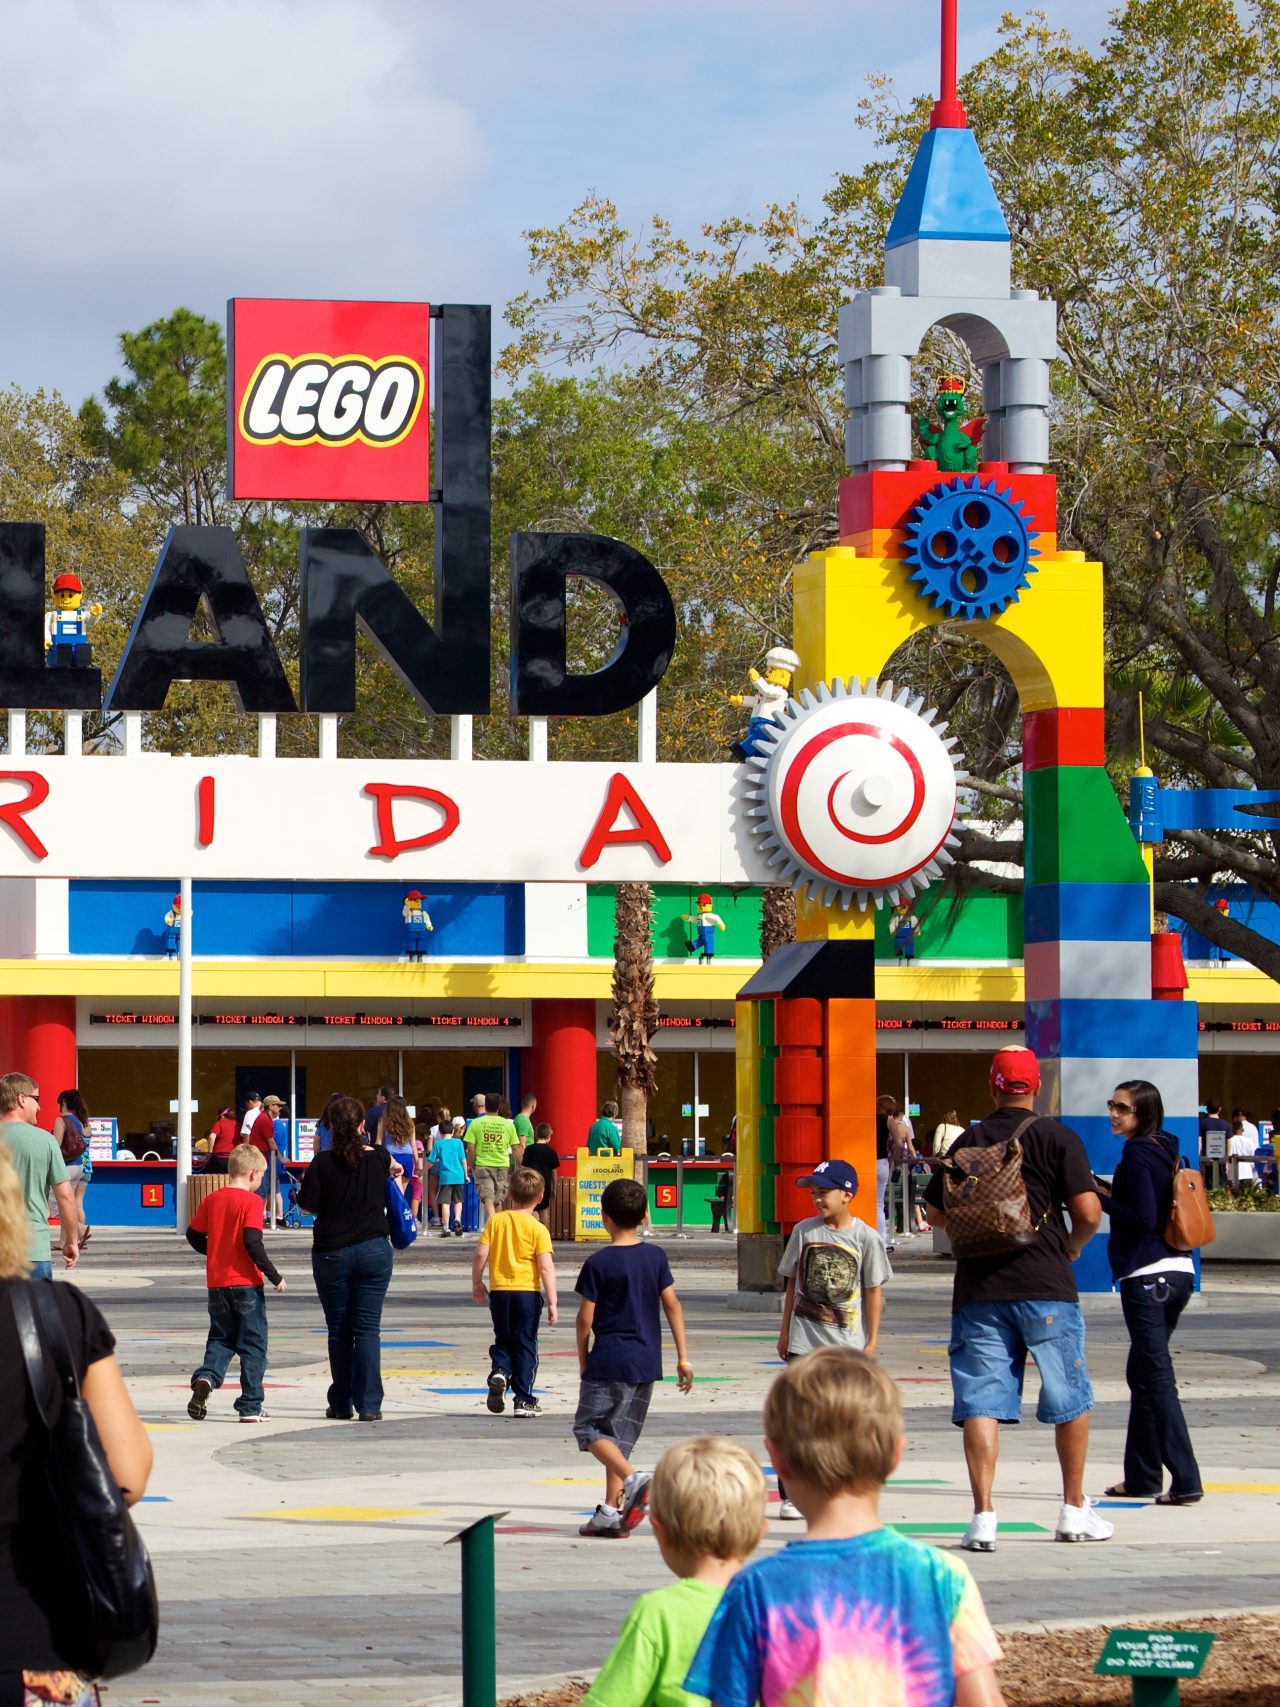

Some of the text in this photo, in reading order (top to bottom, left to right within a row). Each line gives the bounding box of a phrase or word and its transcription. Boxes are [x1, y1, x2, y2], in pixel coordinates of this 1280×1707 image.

[246, 361, 417, 438] LEGO
[105, 1014, 175, 1024] TICKET WINDOW
[215, 1015, 295, 1025] TICKET WINDOW 2
[324, 1015, 403, 1025] TICKET WINDOW 3
[431, 1016, 509, 1026] TICKET WINDOW 4
[659, 1018, 702, 1027] WINDOW 5
[876, 1019, 913, 1028] INDOW 7
[941, 1020, 972, 1029] TICKET
[976, 1020, 1008, 1029] WINDOW
[1231, 1022, 1280, 1031] TICKET WIN
[483, 1133, 503, 1144] 992
[592, 1164, 624, 1174] LEGOLAND
[579, 1180, 607, 1190] GUESTS
[148, 1187, 158, 1203] 1
[588, 1193, 602, 1203] TIC
[661, 1188, 672, 1203] 5
[581, 1206, 602, 1216] PROC
[1116, 1641, 1150, 1651] YOUR
[1105, 1657, 1195, 1670] DO NOT CLIMB
